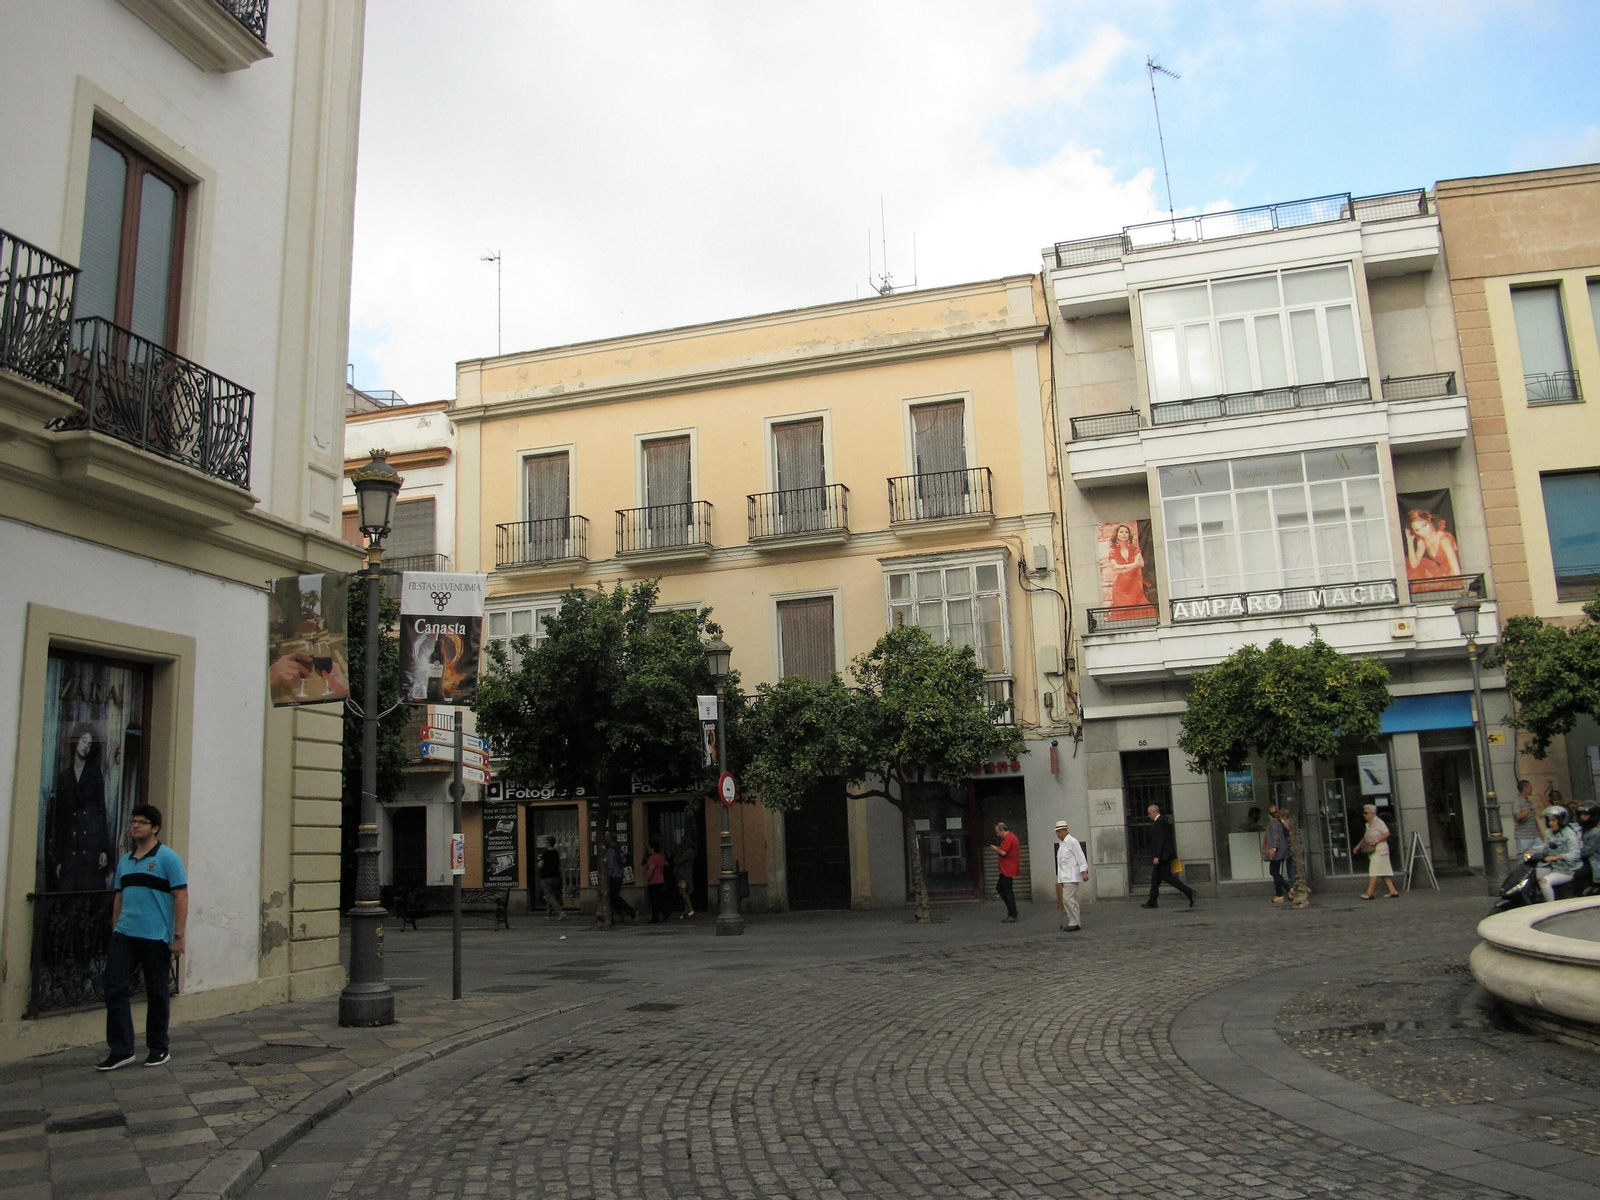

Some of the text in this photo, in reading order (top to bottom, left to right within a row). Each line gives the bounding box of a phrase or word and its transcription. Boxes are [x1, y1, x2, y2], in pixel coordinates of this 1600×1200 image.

[408, 582, 436, 591] FIESTAS
[445, 583, 481, 592] VENDIMIA
[1173, 594, 1282, 619] AMPARO
[414, 618, 466, 635] Canasta
